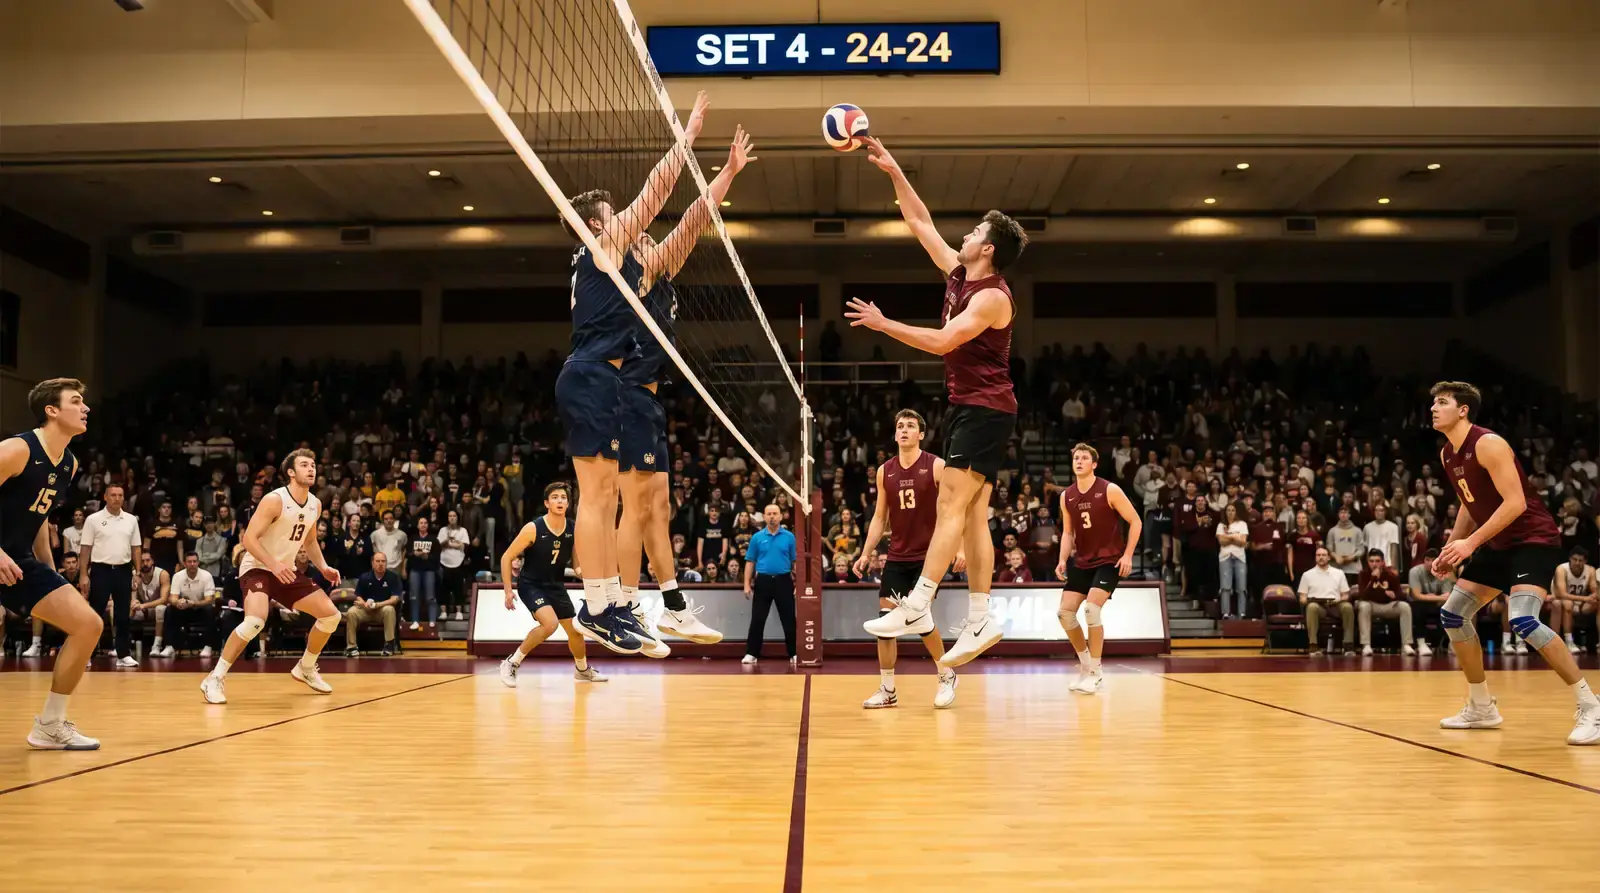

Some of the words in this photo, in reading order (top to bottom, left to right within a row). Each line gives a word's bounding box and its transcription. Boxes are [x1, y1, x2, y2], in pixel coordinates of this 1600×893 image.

[695, 33, 776, 65] SET
[785, 32, 810, 64] 4
[821, 47, 836, 56] -
[846, 31, 953, 63] 24-24
[28, 487, 58, 515] 15
[899, 489, 916, 510] 13
[1081, 512, 1092, 529] 3
[289, 524, 305, 541] 13
[551, 549, 560, 565] 7
